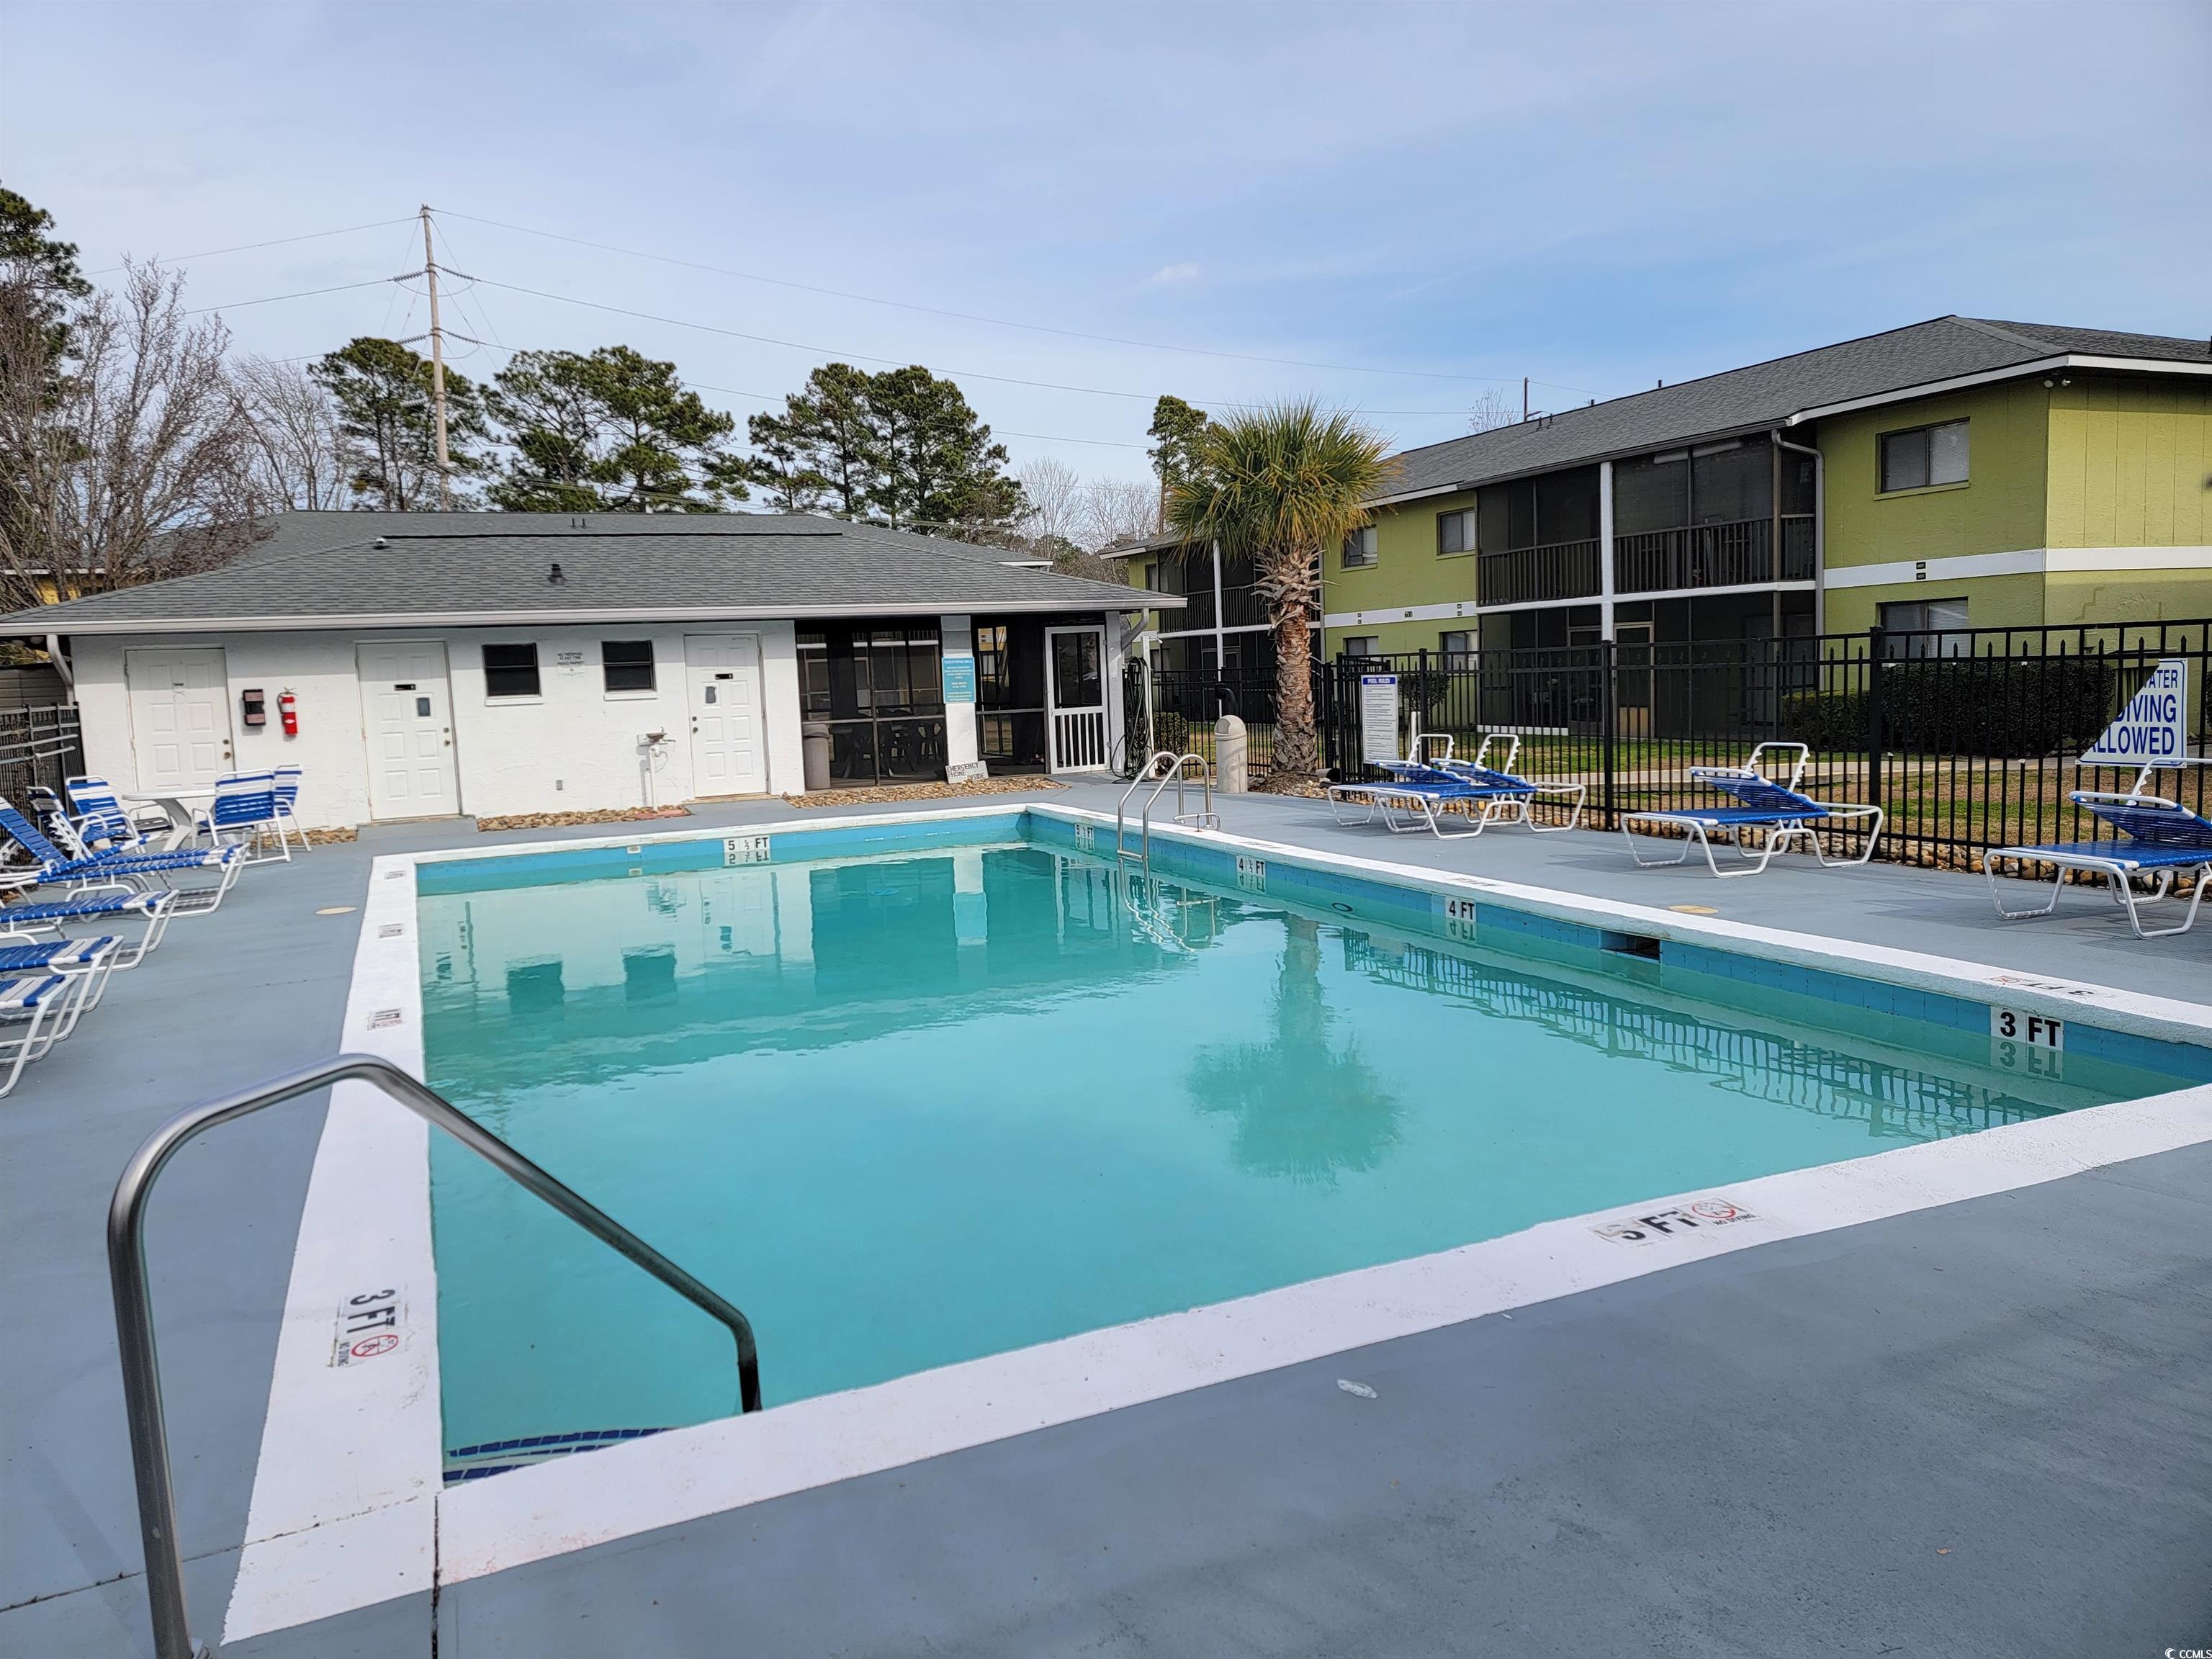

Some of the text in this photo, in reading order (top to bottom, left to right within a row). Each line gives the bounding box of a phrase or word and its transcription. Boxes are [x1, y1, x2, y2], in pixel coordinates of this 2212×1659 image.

[2144, 670, 2178, 688] ATER
[2092, 726, 2175, 755] LLOWED
[947, 762, 979, 773] EMERGENCY
[728, 840, 735, 850] 5
[755, 837, 768, 848] FT
[1239, 858, 1244, 871] 4
[1256, 860, 1264, 875] FT
[1449, 901, 1475, 920] 4 FT
[2000, 1012, 2061, 1047] 3 FT
[1639, 1211, 1700, 1233] FT
[346, 1290, 395, 1334] 3 FT
